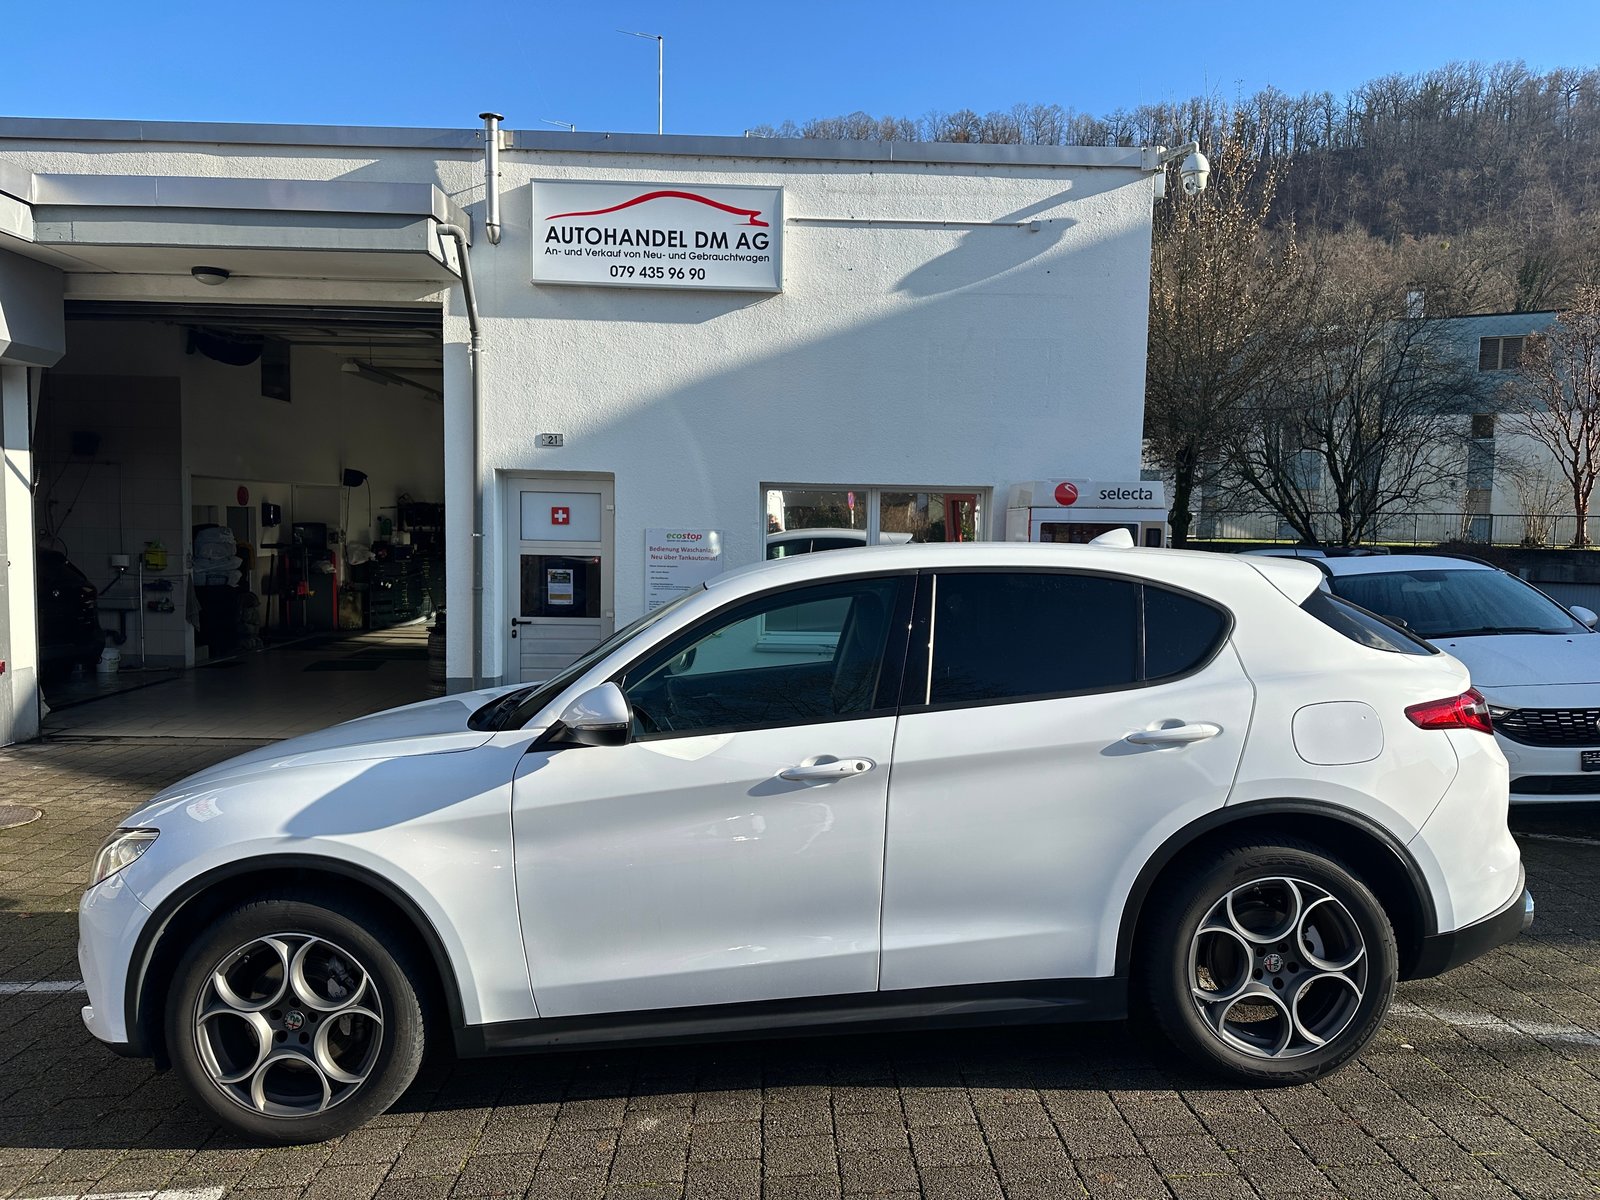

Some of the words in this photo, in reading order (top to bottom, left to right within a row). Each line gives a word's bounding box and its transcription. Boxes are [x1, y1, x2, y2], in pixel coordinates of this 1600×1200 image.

[545, 226, 688, 248] AUTOHANDEL
[695, 231, 729, 249] DM
[735, 232, 770, 250] AG
[545, 247, 562, 255] An-
[564, 248, 582, 256] und
[585, 248, 621, 258] Verkauf
[643, 250, 666, 259] Neu-
[668, 252, 686, 260] und
[688, 252, 770, 264] Gebrauchtwagen
[610, 265, 635, 278] 079
[639, 266, 664, 279] 435
[668, 267, 685, 280] 96
[689, 268, 706, 280] 90
[548, 435, 558, 445] 21
[1099, 487, 1153, 501] selecta
[666, 532, 703, 541] ecostop
